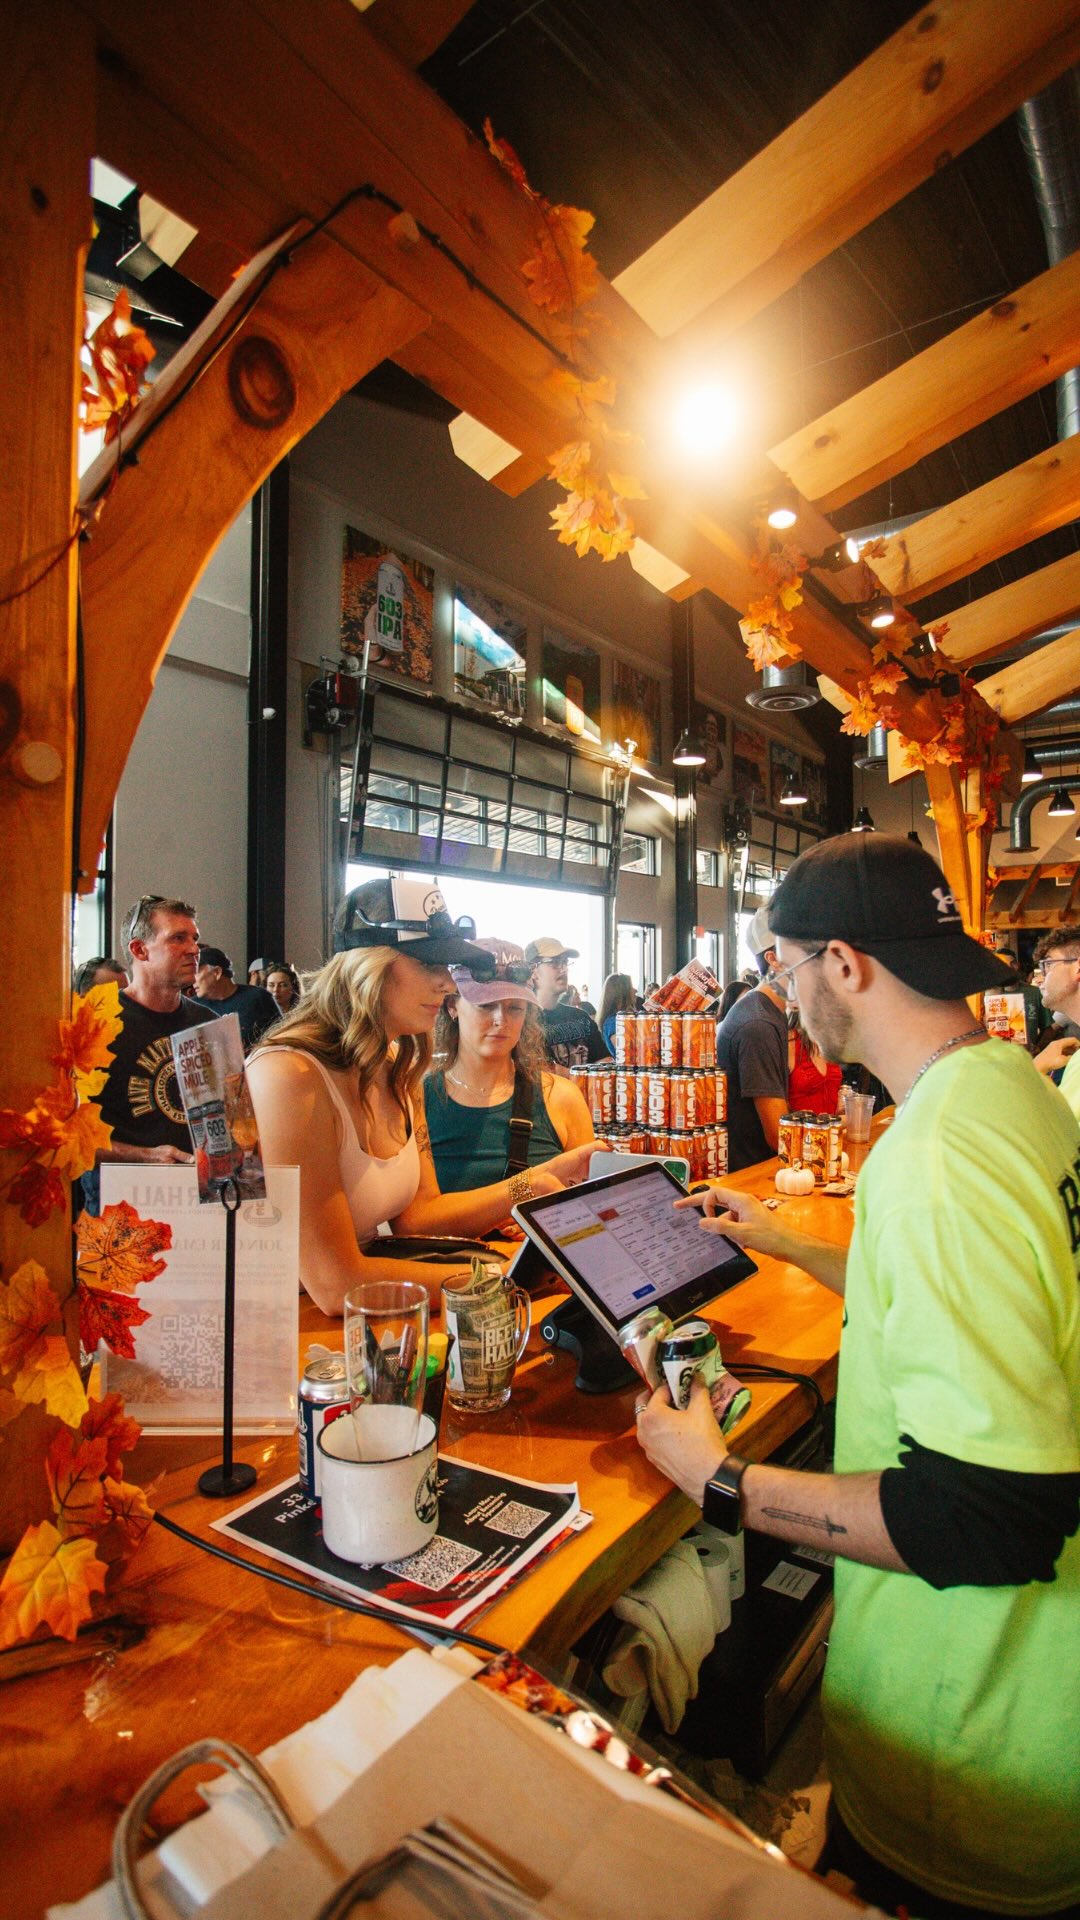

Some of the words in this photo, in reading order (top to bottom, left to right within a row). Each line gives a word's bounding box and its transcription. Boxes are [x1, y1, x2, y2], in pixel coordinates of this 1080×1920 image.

[378, 594, 403, 620] 603
[377, 612, 402, 641] IPA
[136, 1037, 172, 1074] MATT
[178, 1037, 206, 1057] APPLE
[661, 1020, 673, 1065] 603
[181, 1051, 212, 1074] SPICED
[157, 1063, 176, 1112] CHARLOTTESV
[184, 1068, 209, 1089] MULE
[128, 1076, 152, 1117] DAVE
[616, 1078, 627, 1122] 603
[649, 1080, 665, 1125] 603
[206, 1119, 226, 1137] 603
[274, 1498, 317, 1524] Pinke
